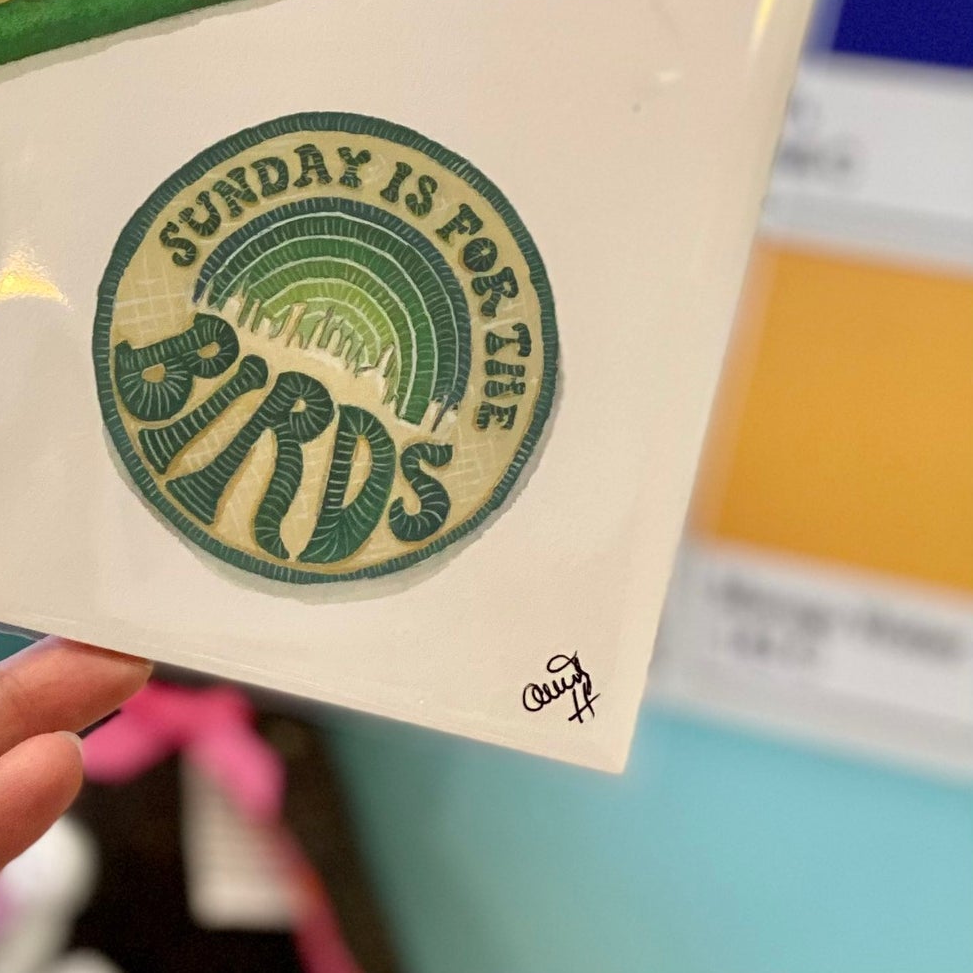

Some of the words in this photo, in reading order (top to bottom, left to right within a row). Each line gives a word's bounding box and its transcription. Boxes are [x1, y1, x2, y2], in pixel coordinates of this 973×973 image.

[159, 143, 372, 266] SUNDAY
[379, 161, 439, 217] IS
[436, 203, 519, 318] FOR
[475, 323, 532, 431] THE
[114, 312, 454, 563] BIRDS
